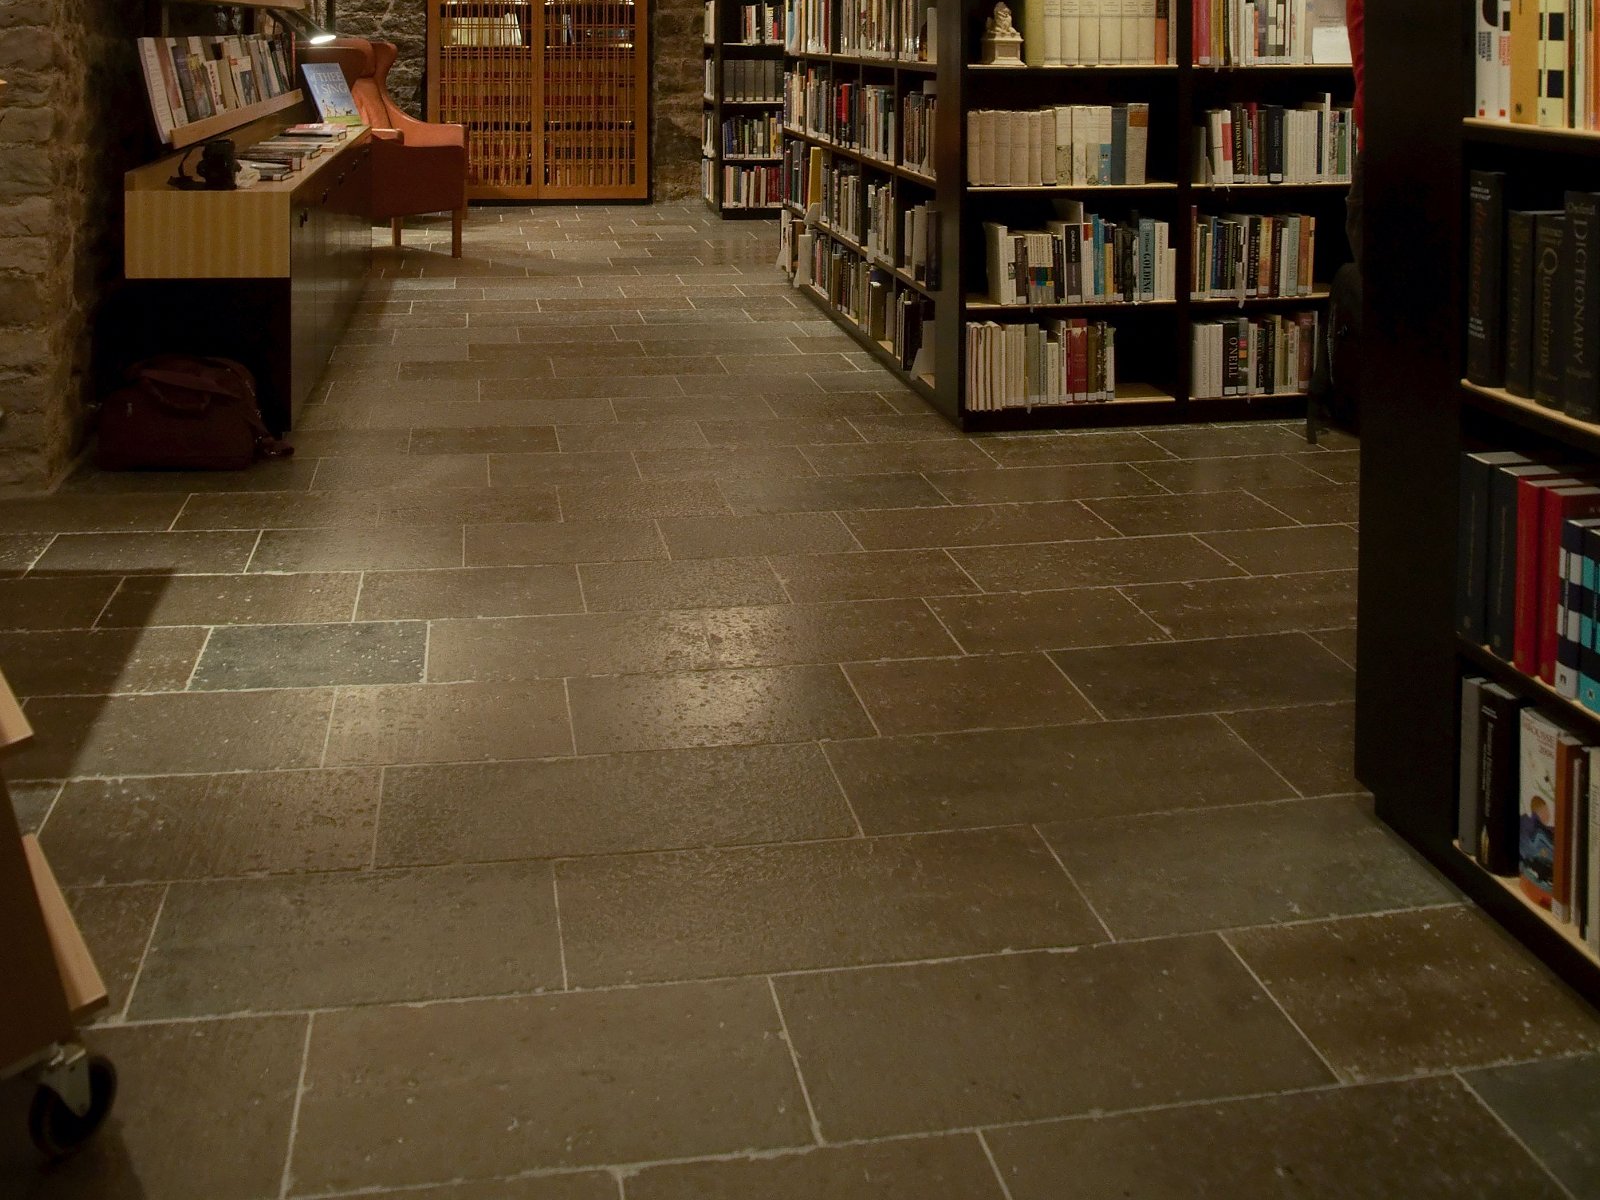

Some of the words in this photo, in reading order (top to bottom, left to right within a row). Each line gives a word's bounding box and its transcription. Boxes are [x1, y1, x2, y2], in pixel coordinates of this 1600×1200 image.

[316, 72, 343, 82] THEE
[321, 83, 346, 95] SING
[1234, 121, 1242, 149] THOMAS
[1143, 253, 1151, 293] GOLDING
[1573, 219, 1588, 364] DICTIONARY
[1538, 247, 1559, 368] Quotations
[1228, 337, 1239, 378] O'NEILL
